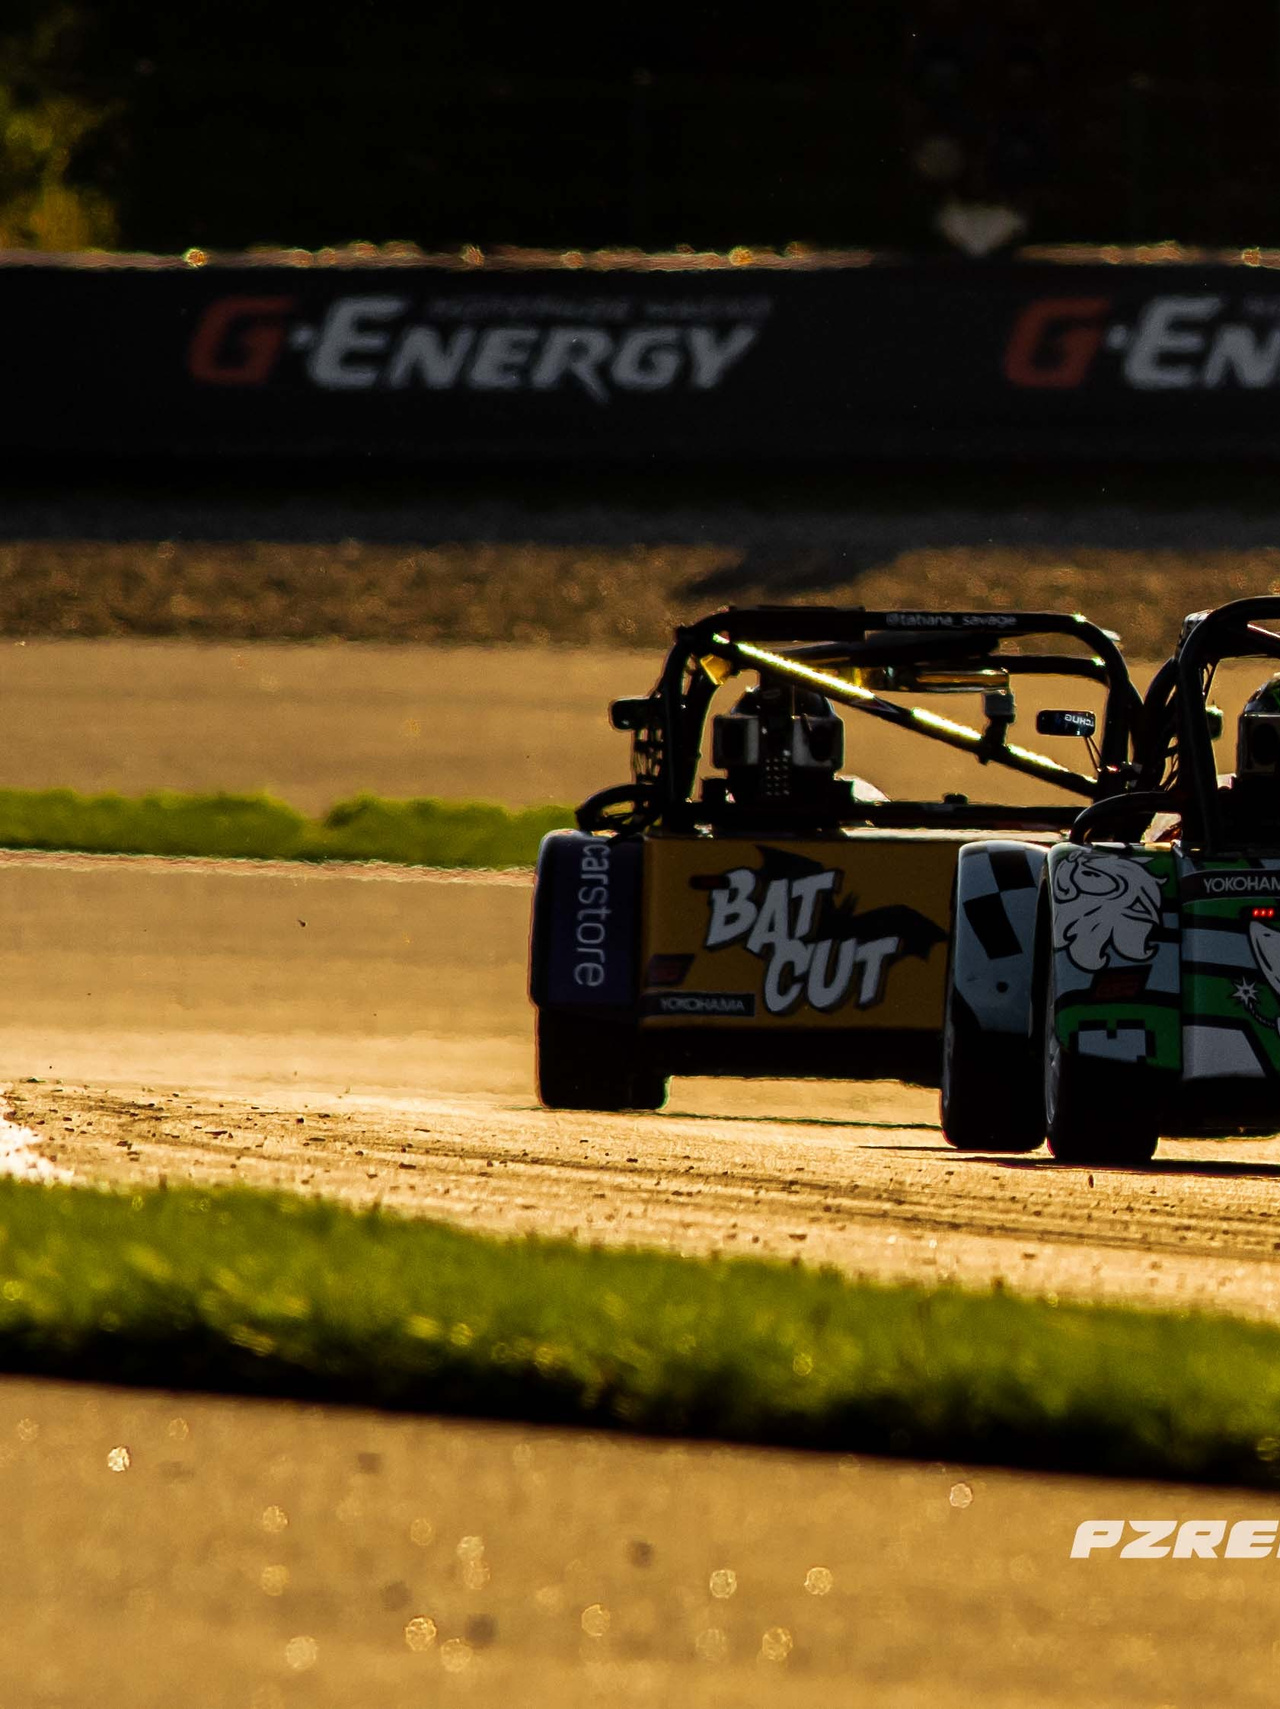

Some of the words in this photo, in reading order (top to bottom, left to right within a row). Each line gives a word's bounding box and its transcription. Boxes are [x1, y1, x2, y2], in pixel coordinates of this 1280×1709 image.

[572, 843, 612, 987] carstore
[704, 867, 837, 956] BAT
[657, 996, 746, 1013] YOKOHAMA
[764, 936, 900, 1014] CUT
